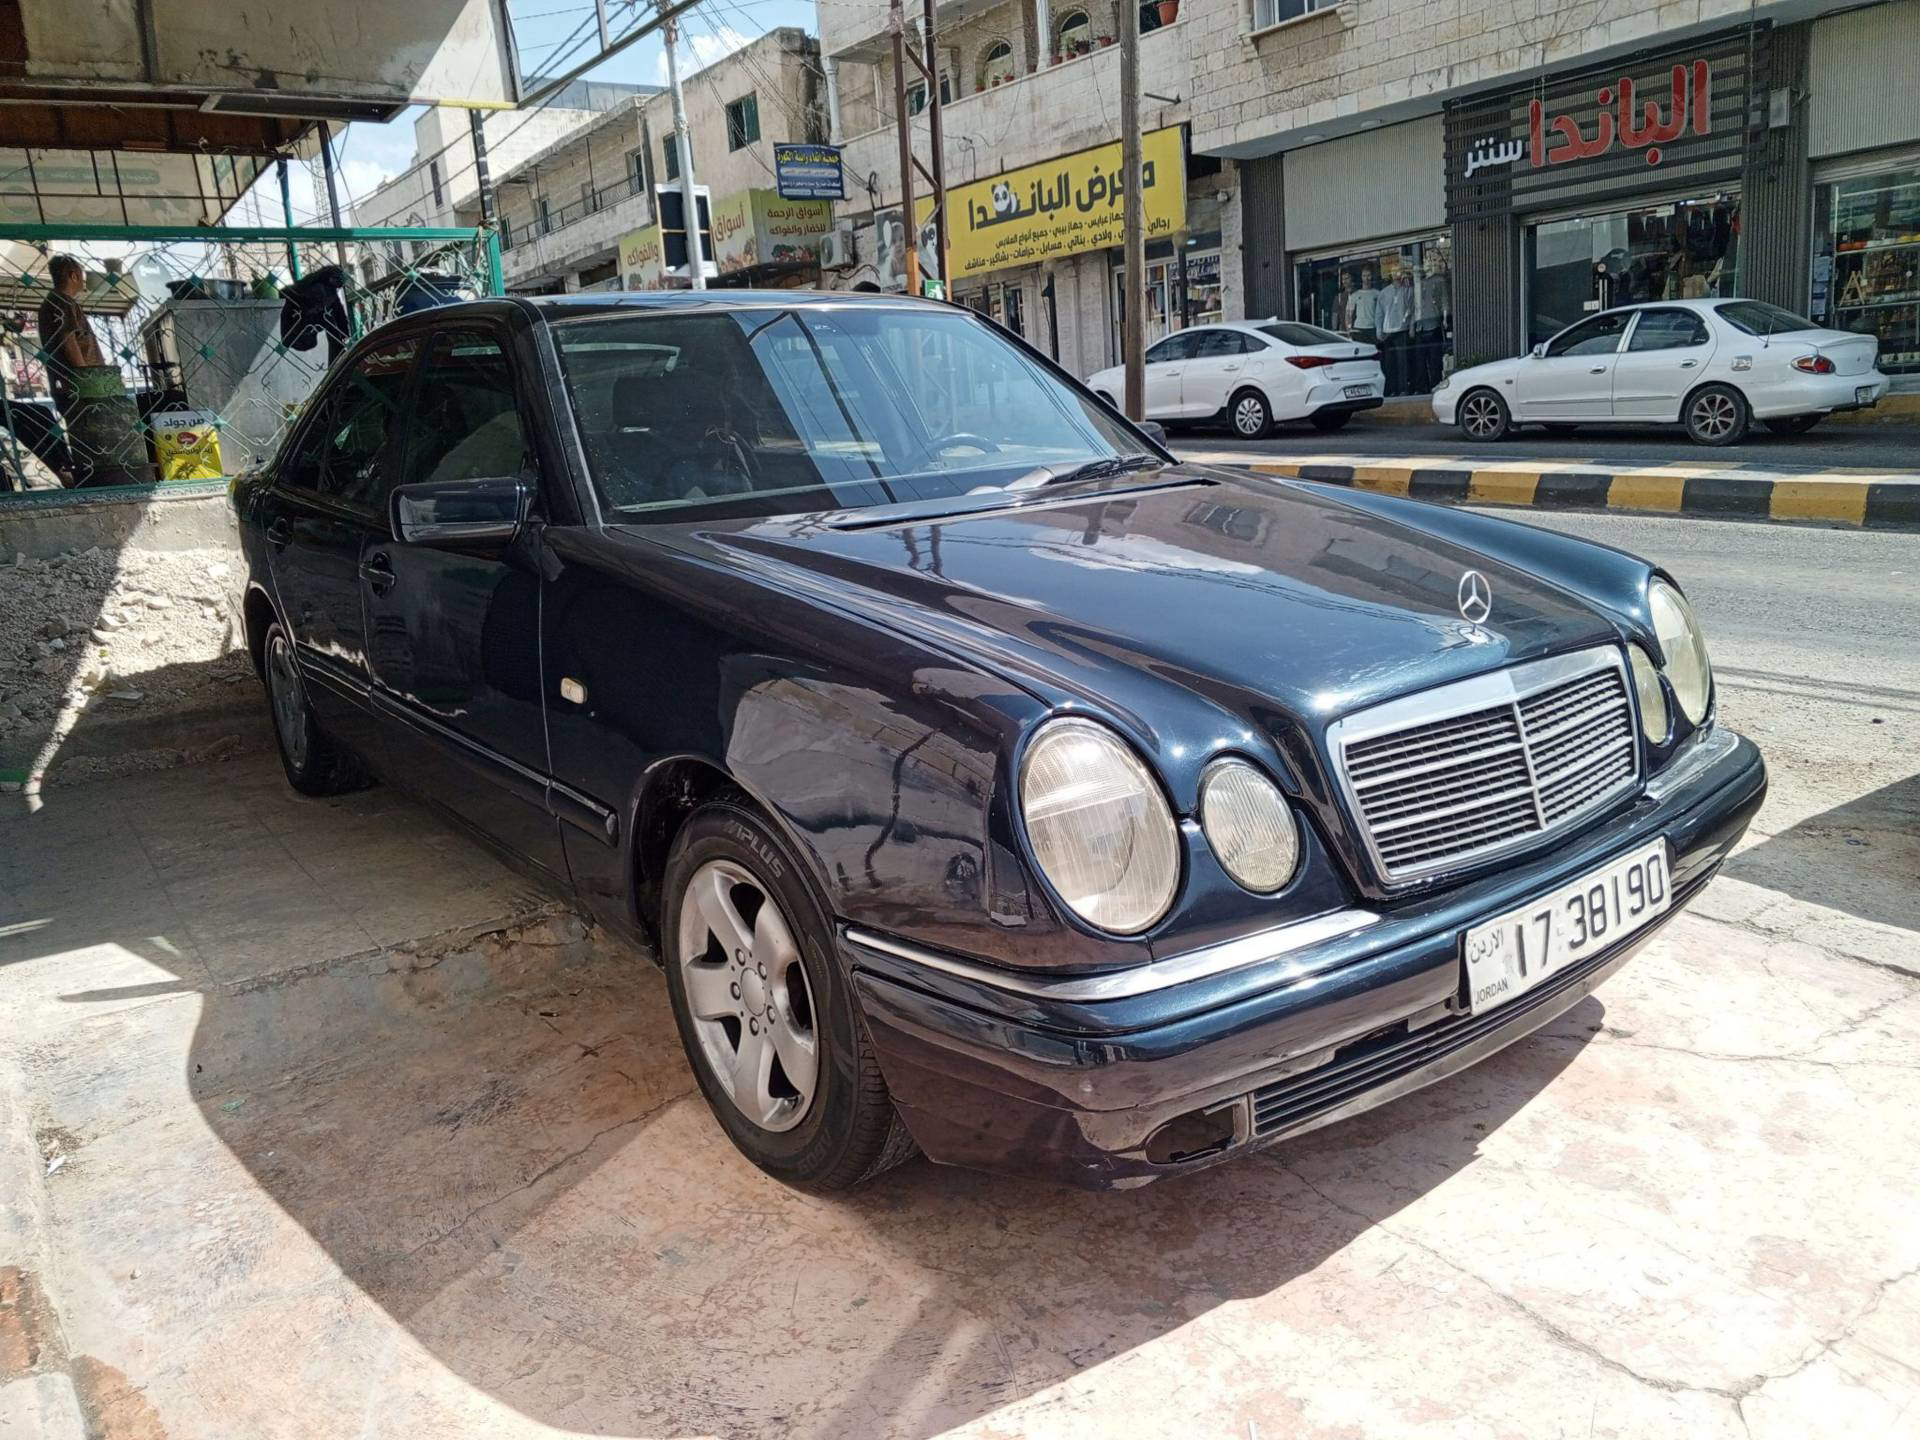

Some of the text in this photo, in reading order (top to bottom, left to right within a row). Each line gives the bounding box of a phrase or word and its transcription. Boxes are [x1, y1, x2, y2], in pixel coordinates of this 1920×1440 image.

[1463, 59, 1712, 179] الباندا سنتر
[968, 171, 1070, 232] الباندا
[1091, 229, 1112, 247] ولادي
[1147, 217, 1170, 232] رجالي
[1474, 978, 1509, 1005] JORDAN
